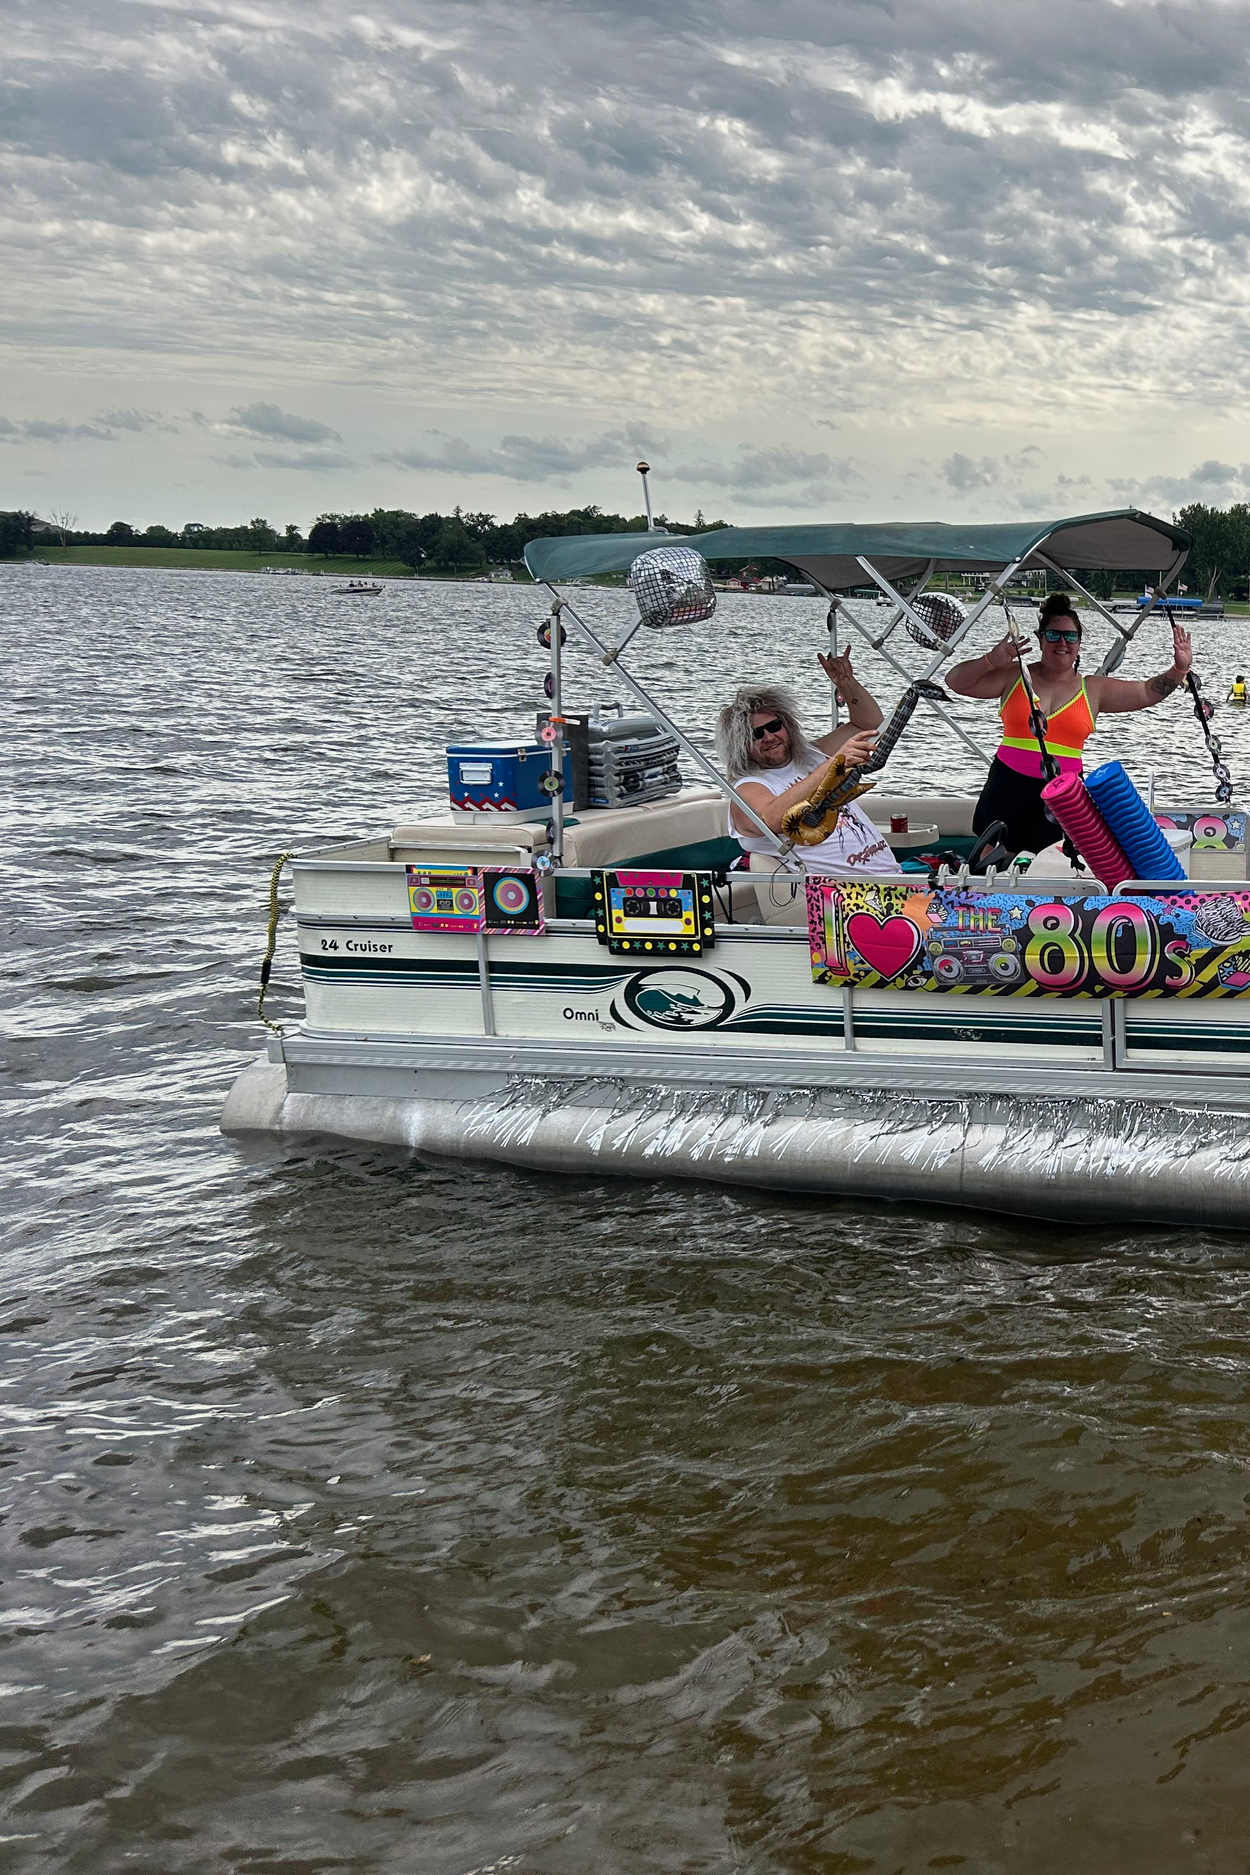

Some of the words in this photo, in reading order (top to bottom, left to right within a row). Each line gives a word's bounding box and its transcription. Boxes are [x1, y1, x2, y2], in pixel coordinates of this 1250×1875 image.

[820, 884, 851, 976] I
[954, 906, 1003, 933] THE
[1026, 902, 1196, 991] 80s
[321, 939, 339, 951] 24
[346, 940, 393, 953] Cruiser
[563, 1007, 599, 1021] Omni
